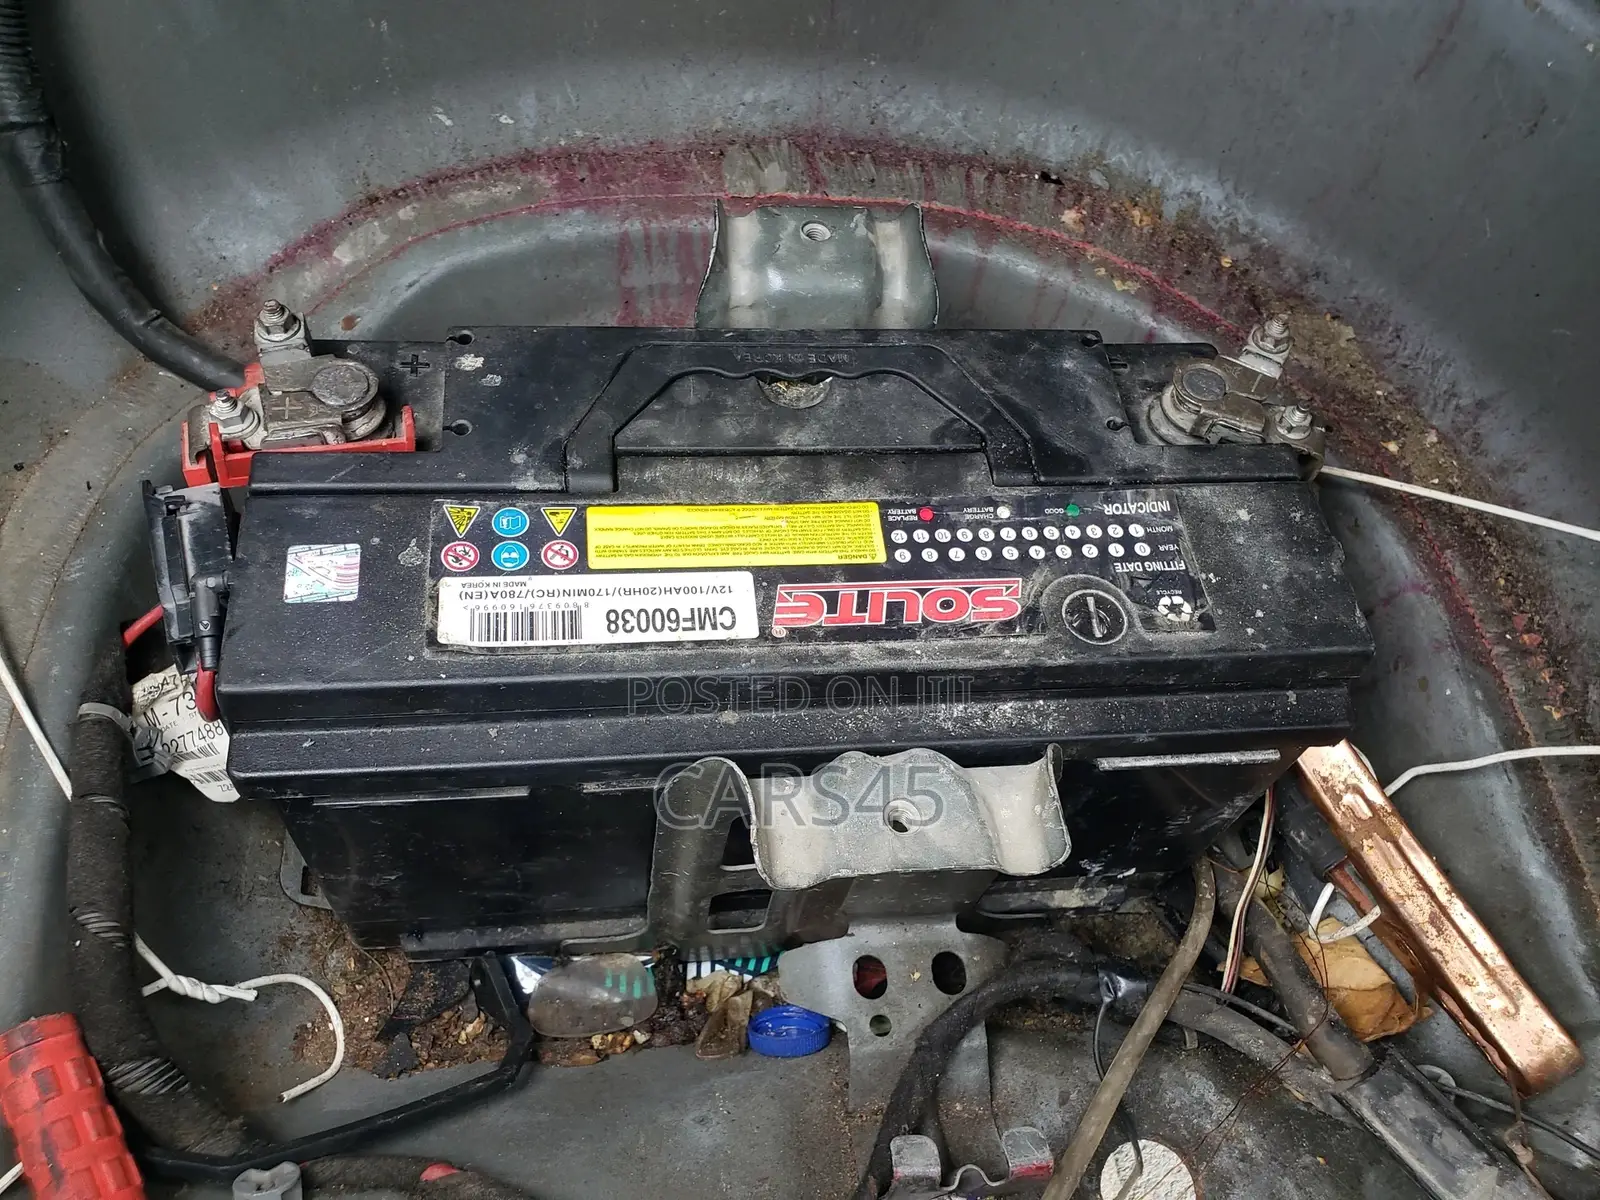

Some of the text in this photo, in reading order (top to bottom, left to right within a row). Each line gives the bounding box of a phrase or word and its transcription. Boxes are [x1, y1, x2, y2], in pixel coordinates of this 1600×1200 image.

[1104, 501, 1170, 514] INDICATOR
[1091, 528, 1097, 536] 3
[1112, 527, 1118, 535] 2
[1134, 526, 1139, 534] 1
[900, 551, 906, 560] 9
[927, 551, 933, 560] 8
[954, 549, 960, 559] 7
[981, 549, 987, 558] 6
[1007, 548, 1014, 558] 5
[1034, 547, 1041, 557] 4
[1060, 547, 1067, 557] 3
[1087, 547, 1093, 555] 2
[1114, 560, 1185, 572] FITTING DATE
[772, 588, 1022, 627] SOLITE
[605, 606, 737, 634] CMF60038
